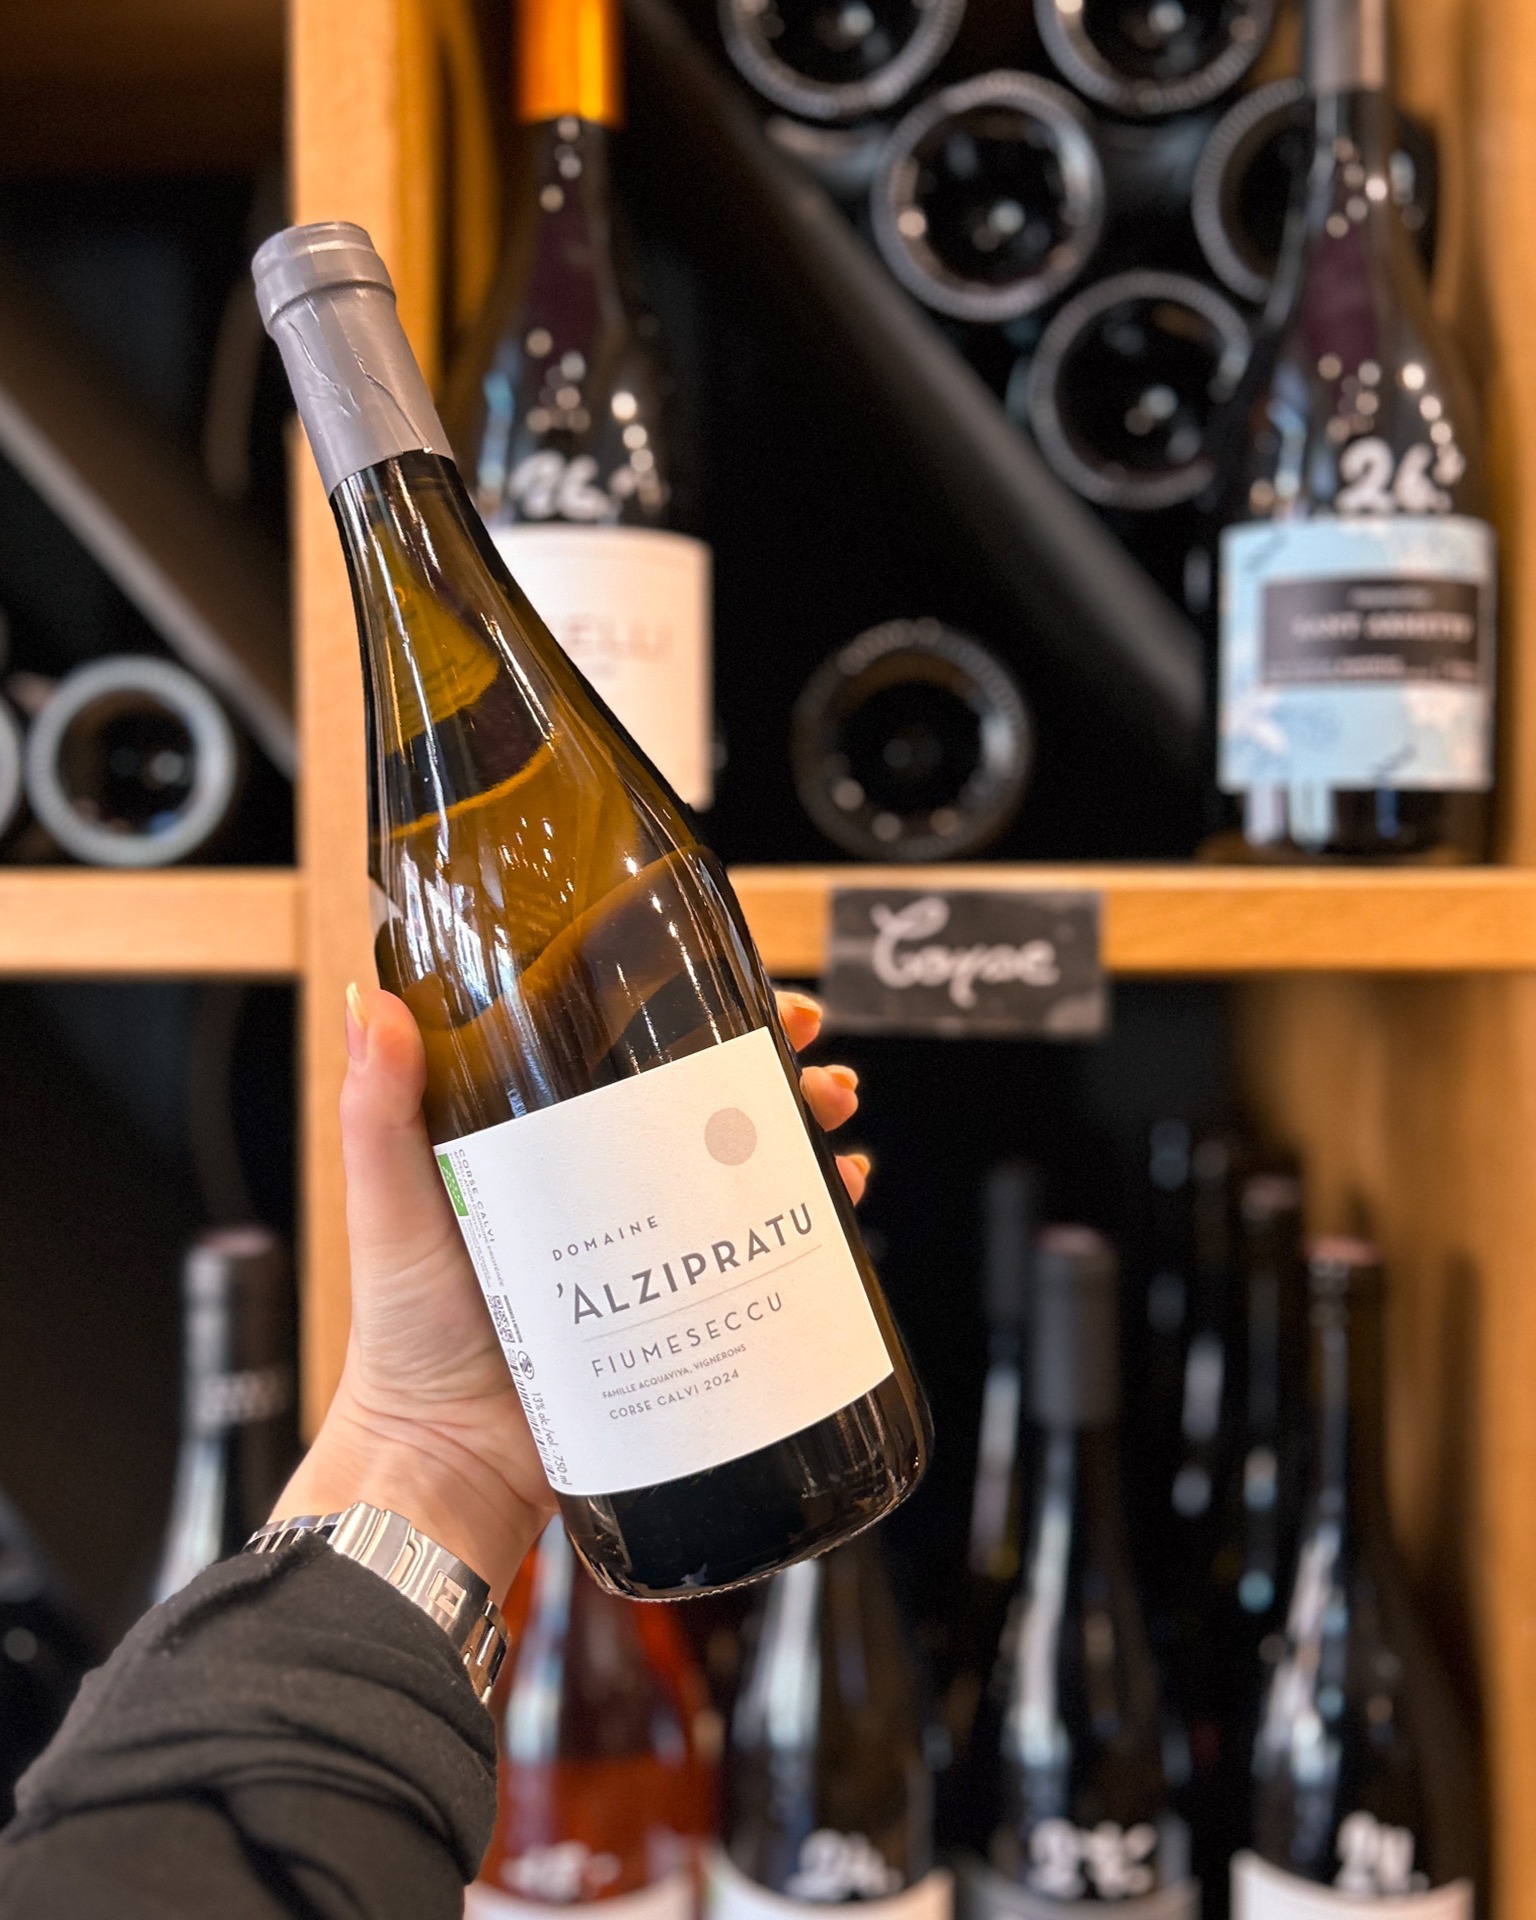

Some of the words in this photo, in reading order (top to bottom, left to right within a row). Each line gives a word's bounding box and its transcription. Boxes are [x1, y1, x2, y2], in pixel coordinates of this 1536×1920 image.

[476, 1200, 496, 1242] CALVI
[551, 1214, 659, 1262] DOMAINE
[591, 1291, 783, 1378] FIUMESECCU
[602, 1382, 637, 1399] FAMILLE
[638, 1366, 693, 1390] ACQUAVIVA,
[692, 1343, 747, 1371] VIGNERONS
[531, 1392, 547, 1411] 13%
[609, 1401, 653, 1421] CORSE
[656, 1384, 700, 1407] CALVI
[703, 1368, 740, 1391] 2024
[553, 1453, 568, 1475] 750
[560, 1475, 573, 1487] ml
